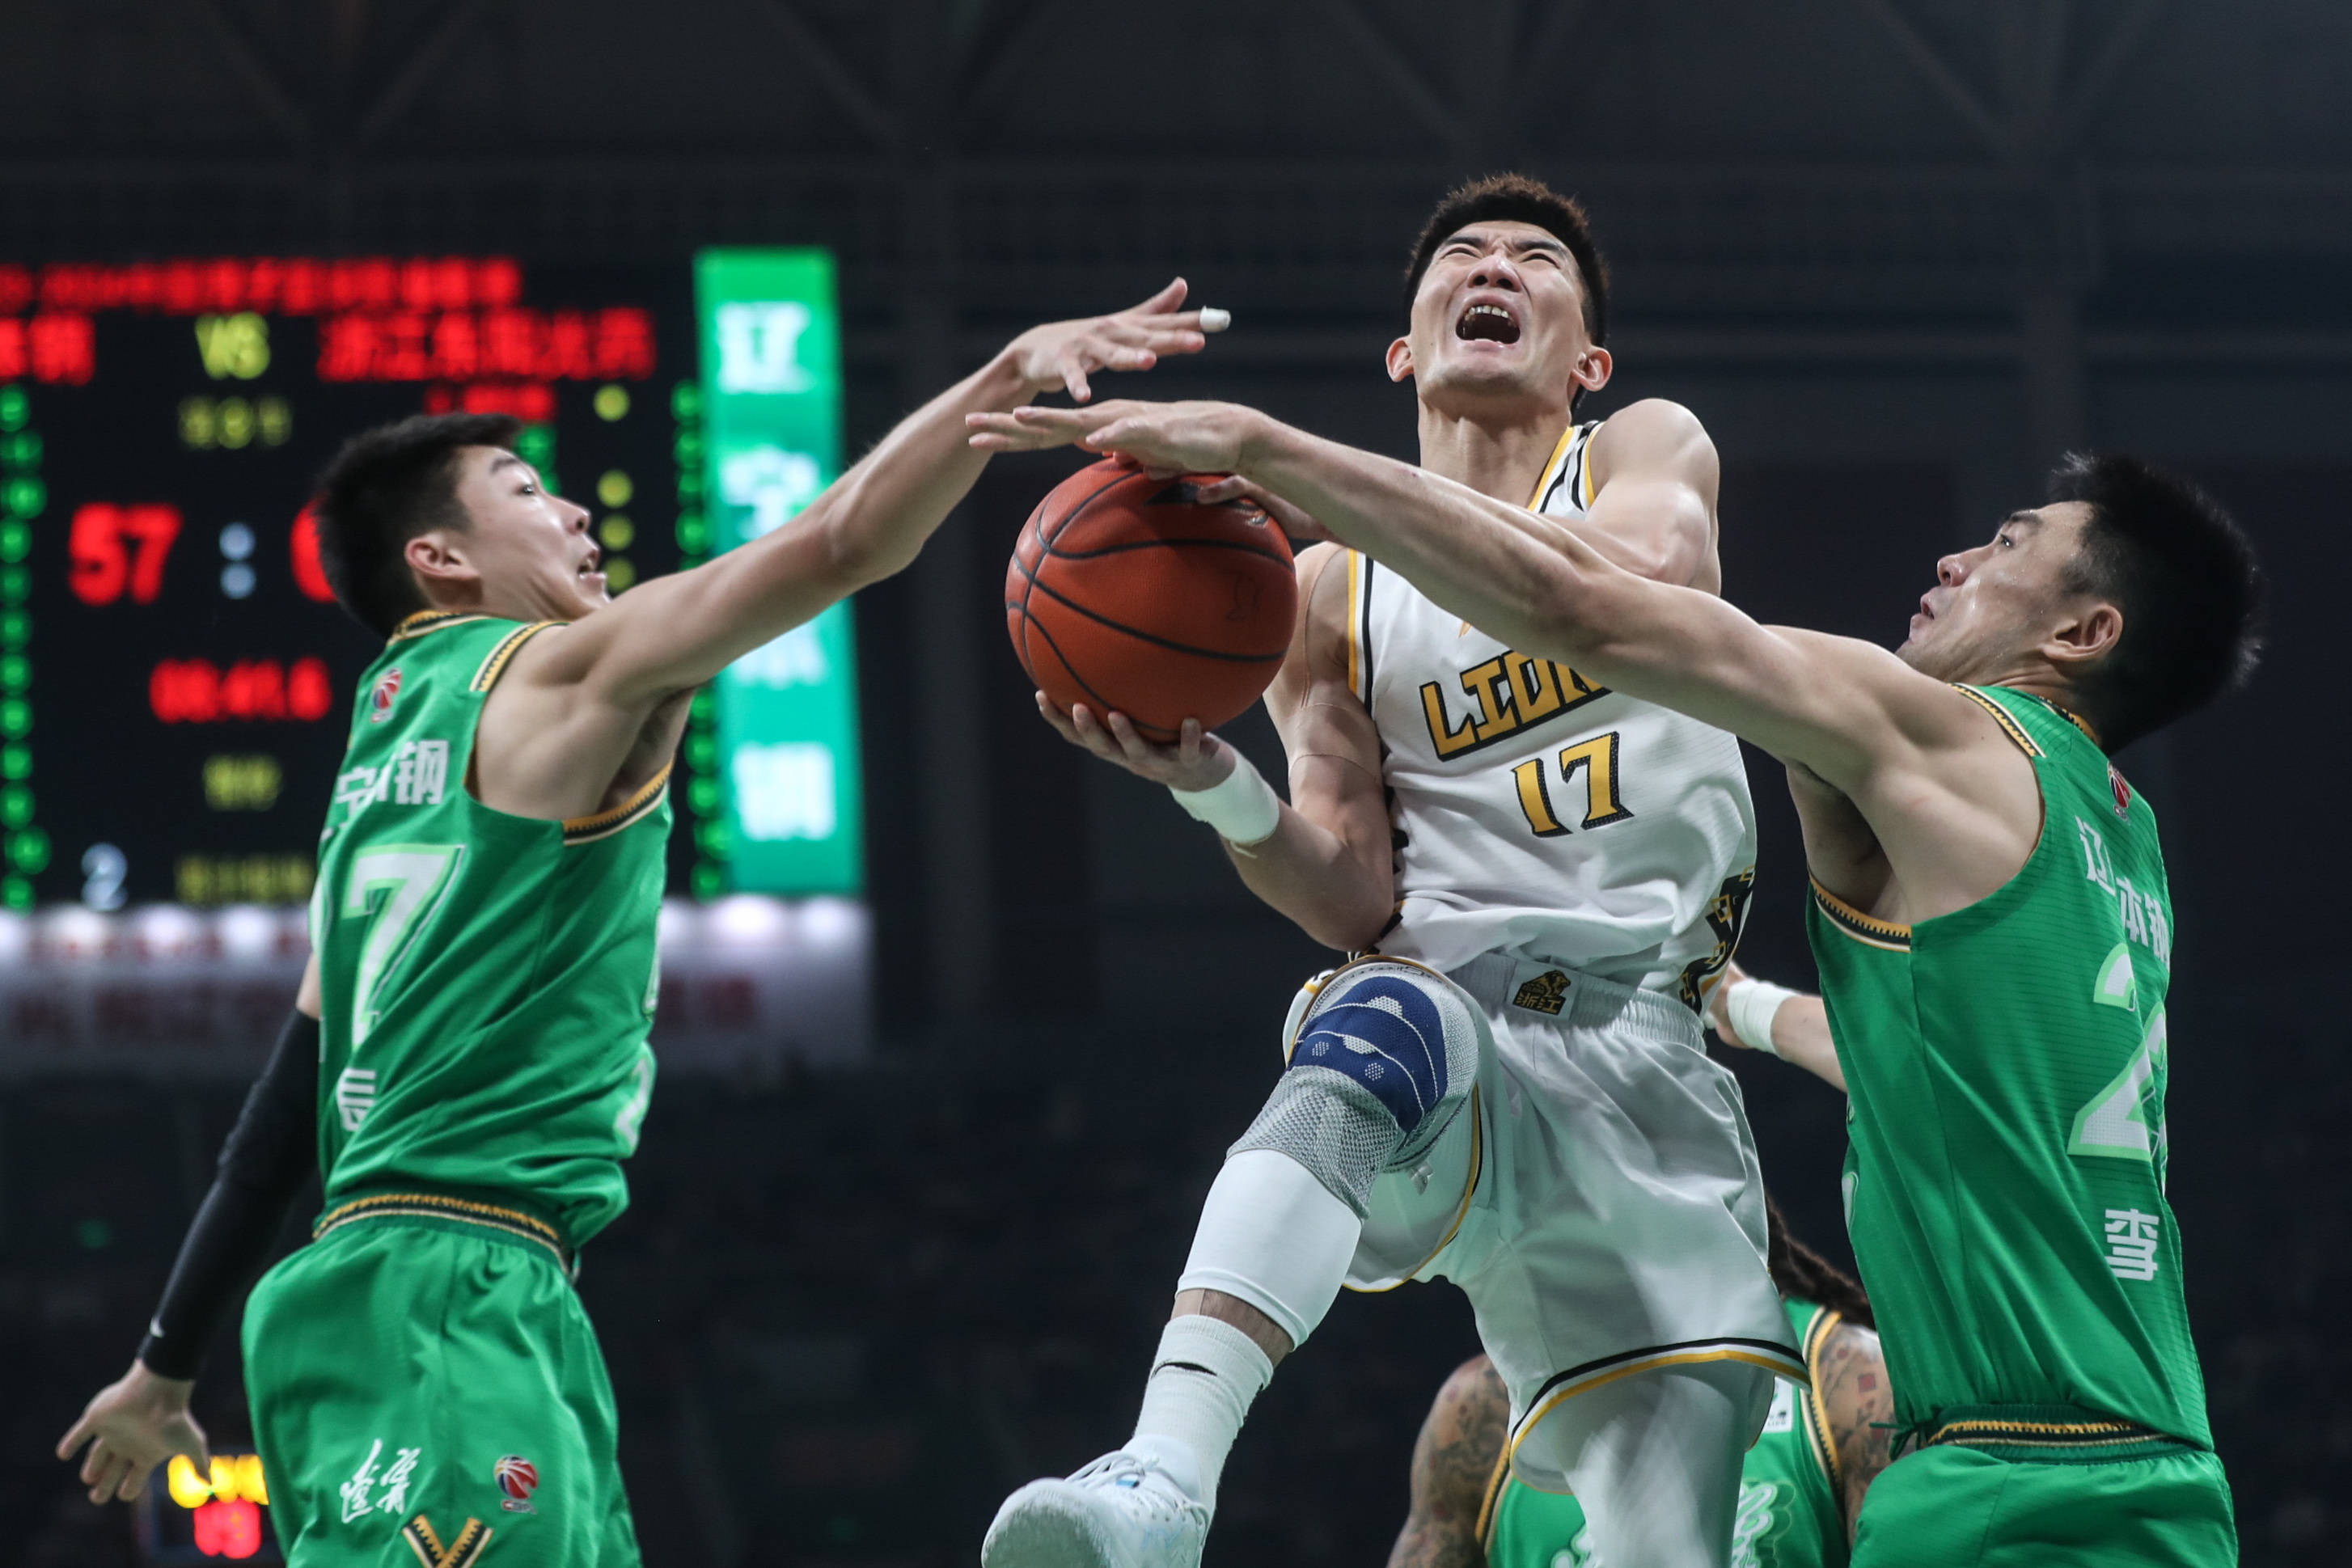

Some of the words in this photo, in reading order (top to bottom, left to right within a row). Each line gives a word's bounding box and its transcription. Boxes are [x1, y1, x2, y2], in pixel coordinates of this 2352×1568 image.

[196, 312, 270, 380] VS
[70, 501, 183, 606] 57
[1511, 732, 1635, 838] 17
